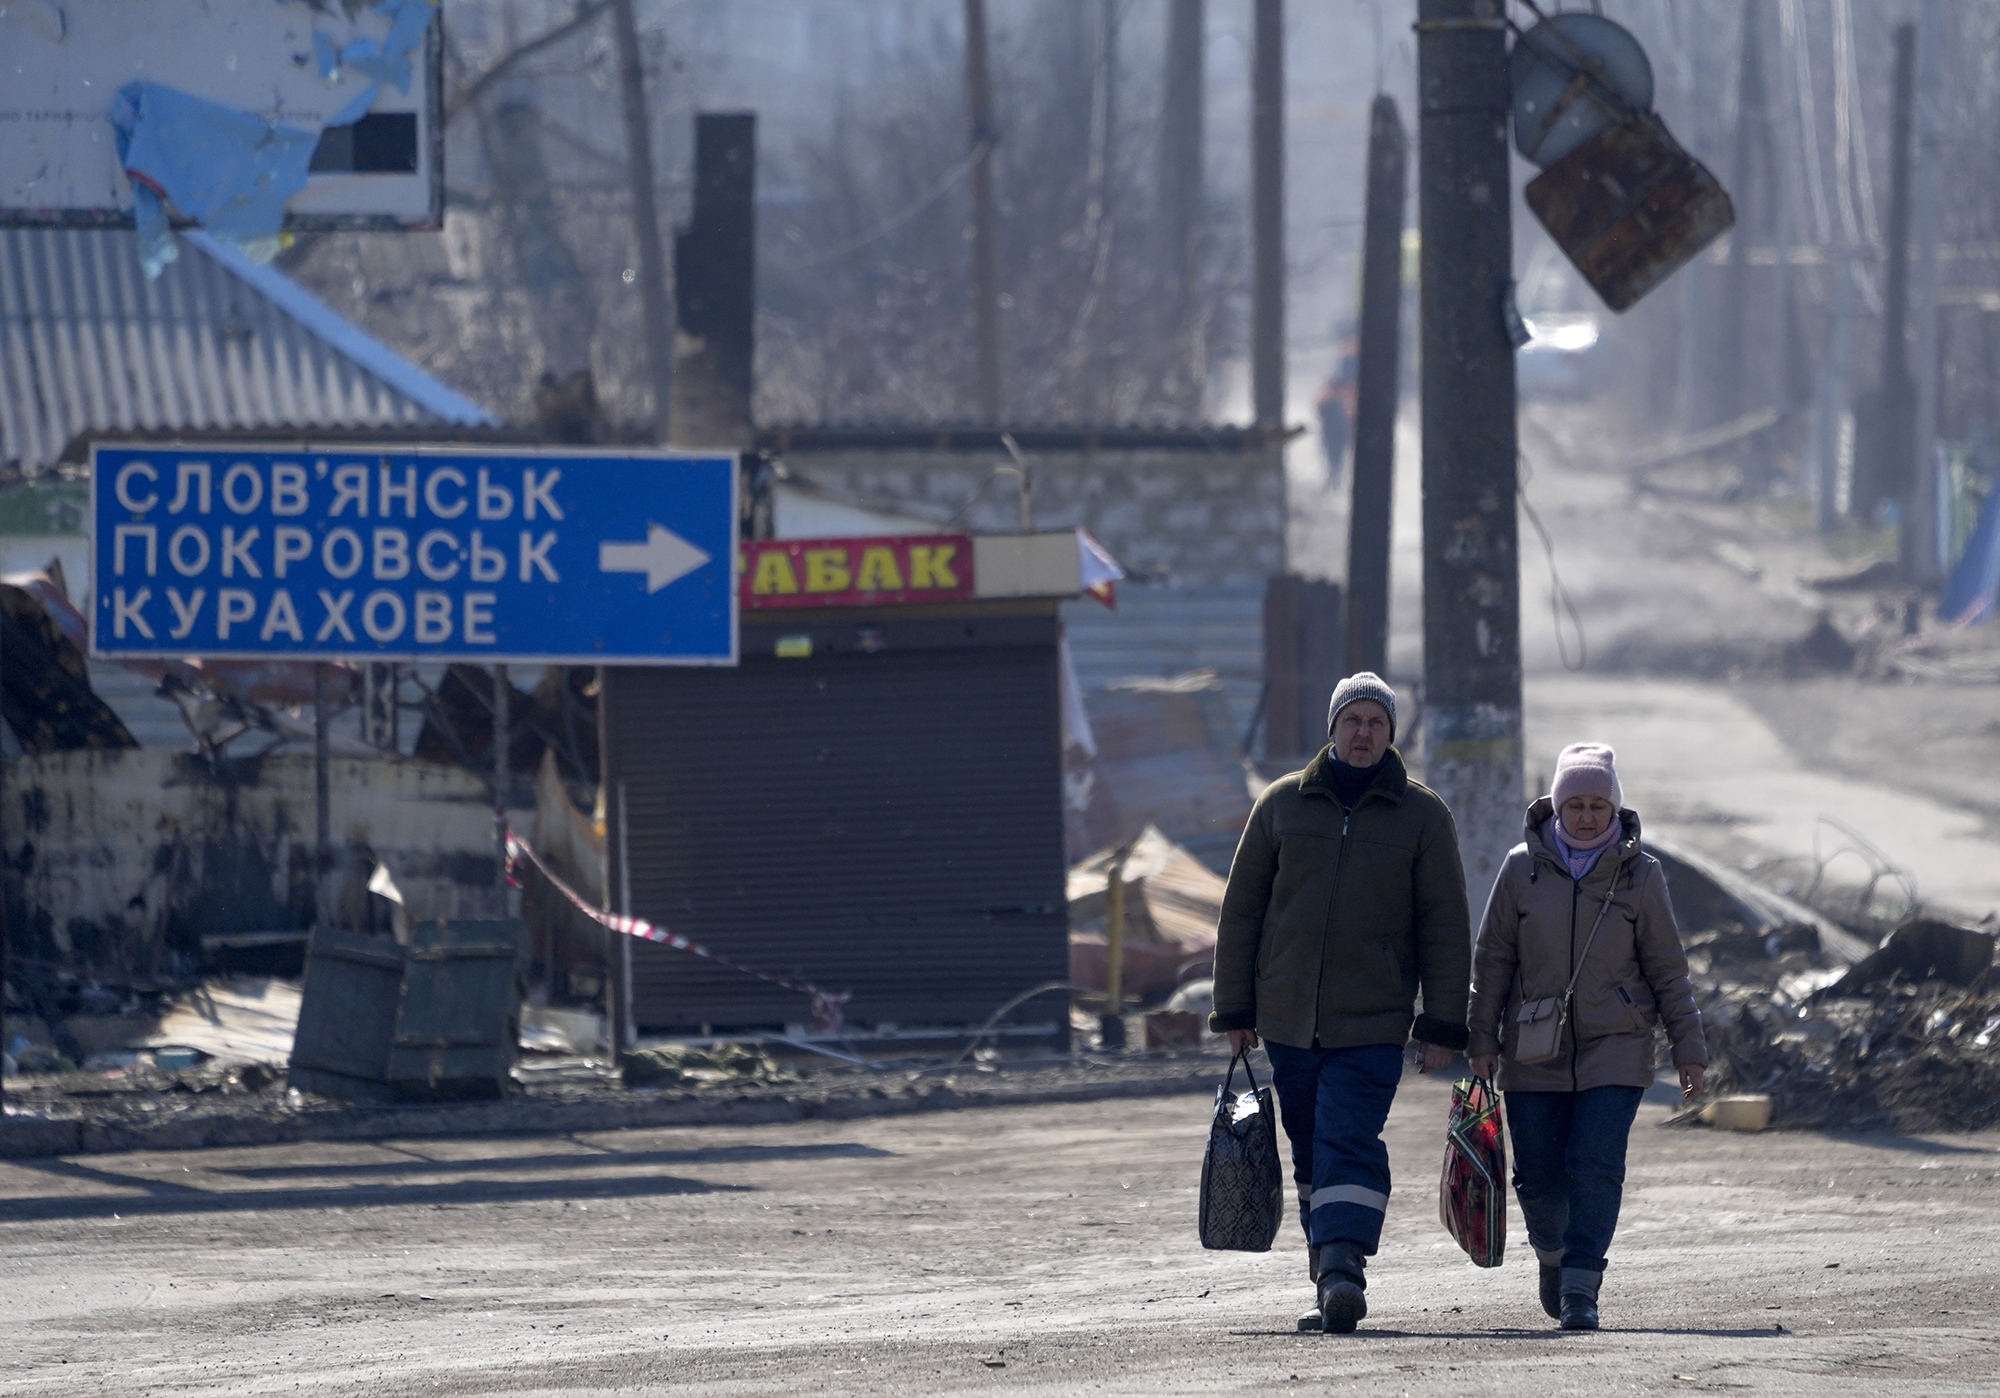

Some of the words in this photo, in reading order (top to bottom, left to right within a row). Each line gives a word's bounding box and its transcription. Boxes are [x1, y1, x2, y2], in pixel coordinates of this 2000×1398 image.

[115, 460, 564, 521] СЛОВ'ЯНСЬК
[113, 524, 560, 584] ПОКРОВСЬК
[738, 545, 957, 595] АБАК
[112, 588, 498, 645] КУРАХОВЕ
